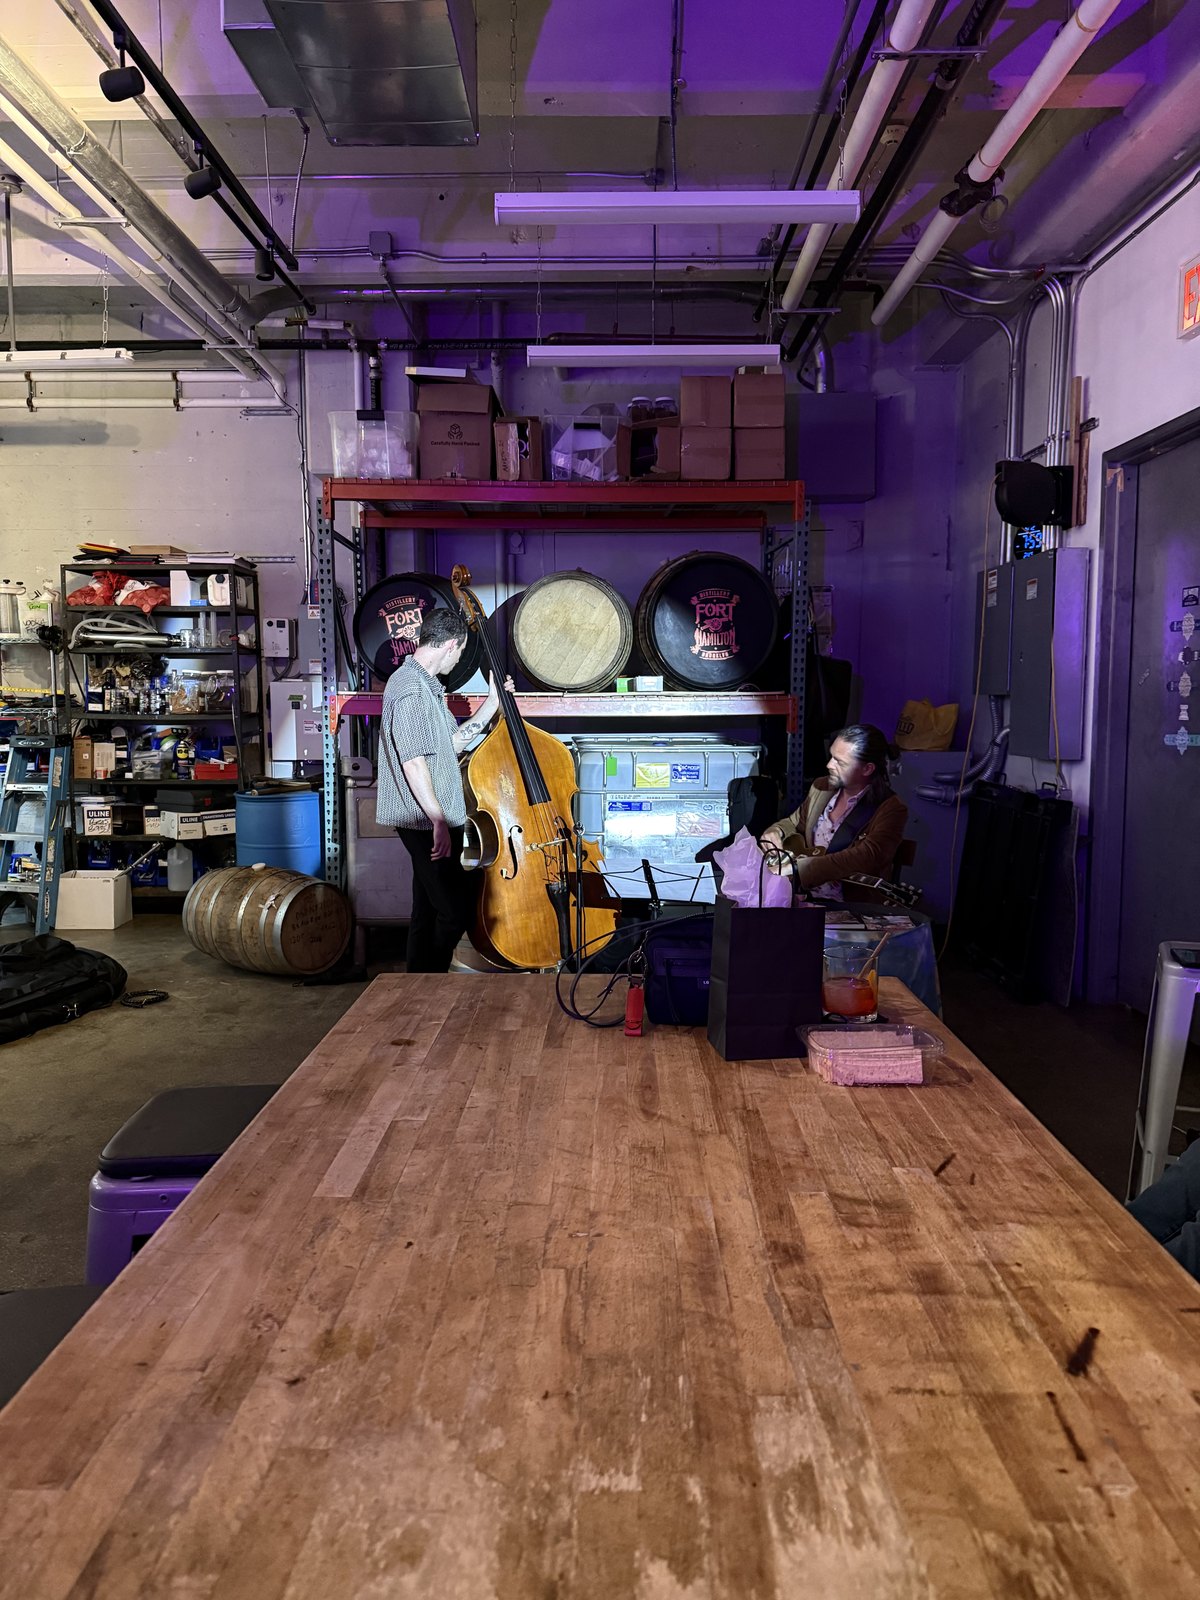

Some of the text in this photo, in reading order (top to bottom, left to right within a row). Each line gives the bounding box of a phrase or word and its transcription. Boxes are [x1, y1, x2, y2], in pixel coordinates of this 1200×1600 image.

[385, 608, 423, 634] FORT
[695, 603, 736, 624] FORT
[694, 626, 736, 646] HAMILTON
